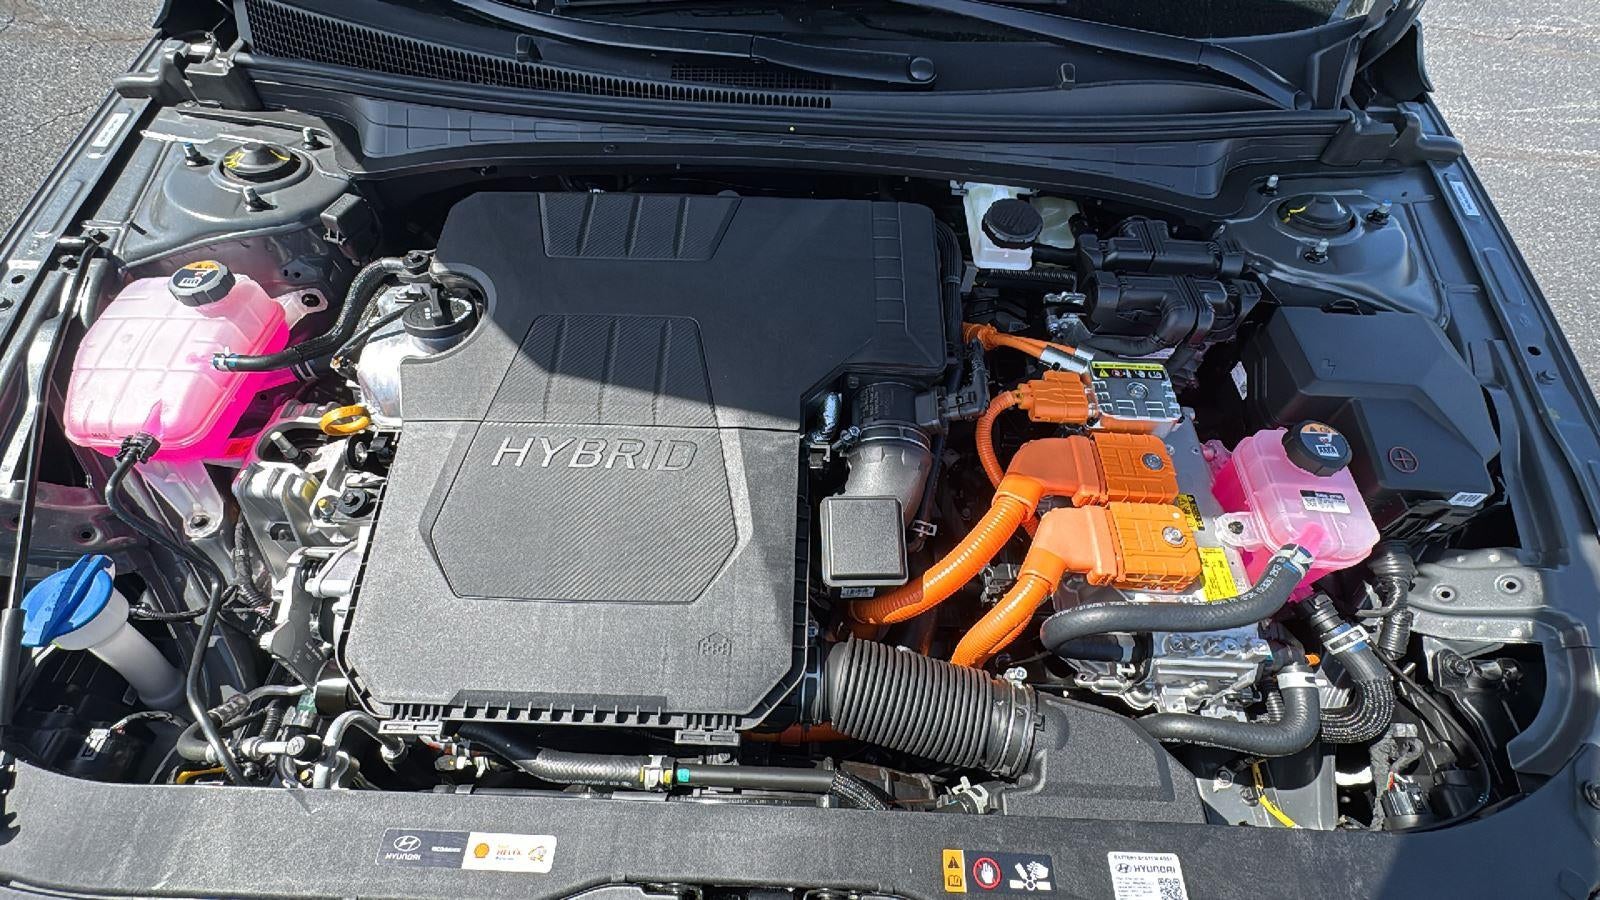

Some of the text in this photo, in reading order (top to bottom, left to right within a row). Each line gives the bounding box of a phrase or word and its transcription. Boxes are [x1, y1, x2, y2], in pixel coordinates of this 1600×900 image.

[491, 437, 698, 471] HYBRID
[385, 852, 421, 861] HYUNDAI
[1133, 864, 1176, 874] HYUNDAI
